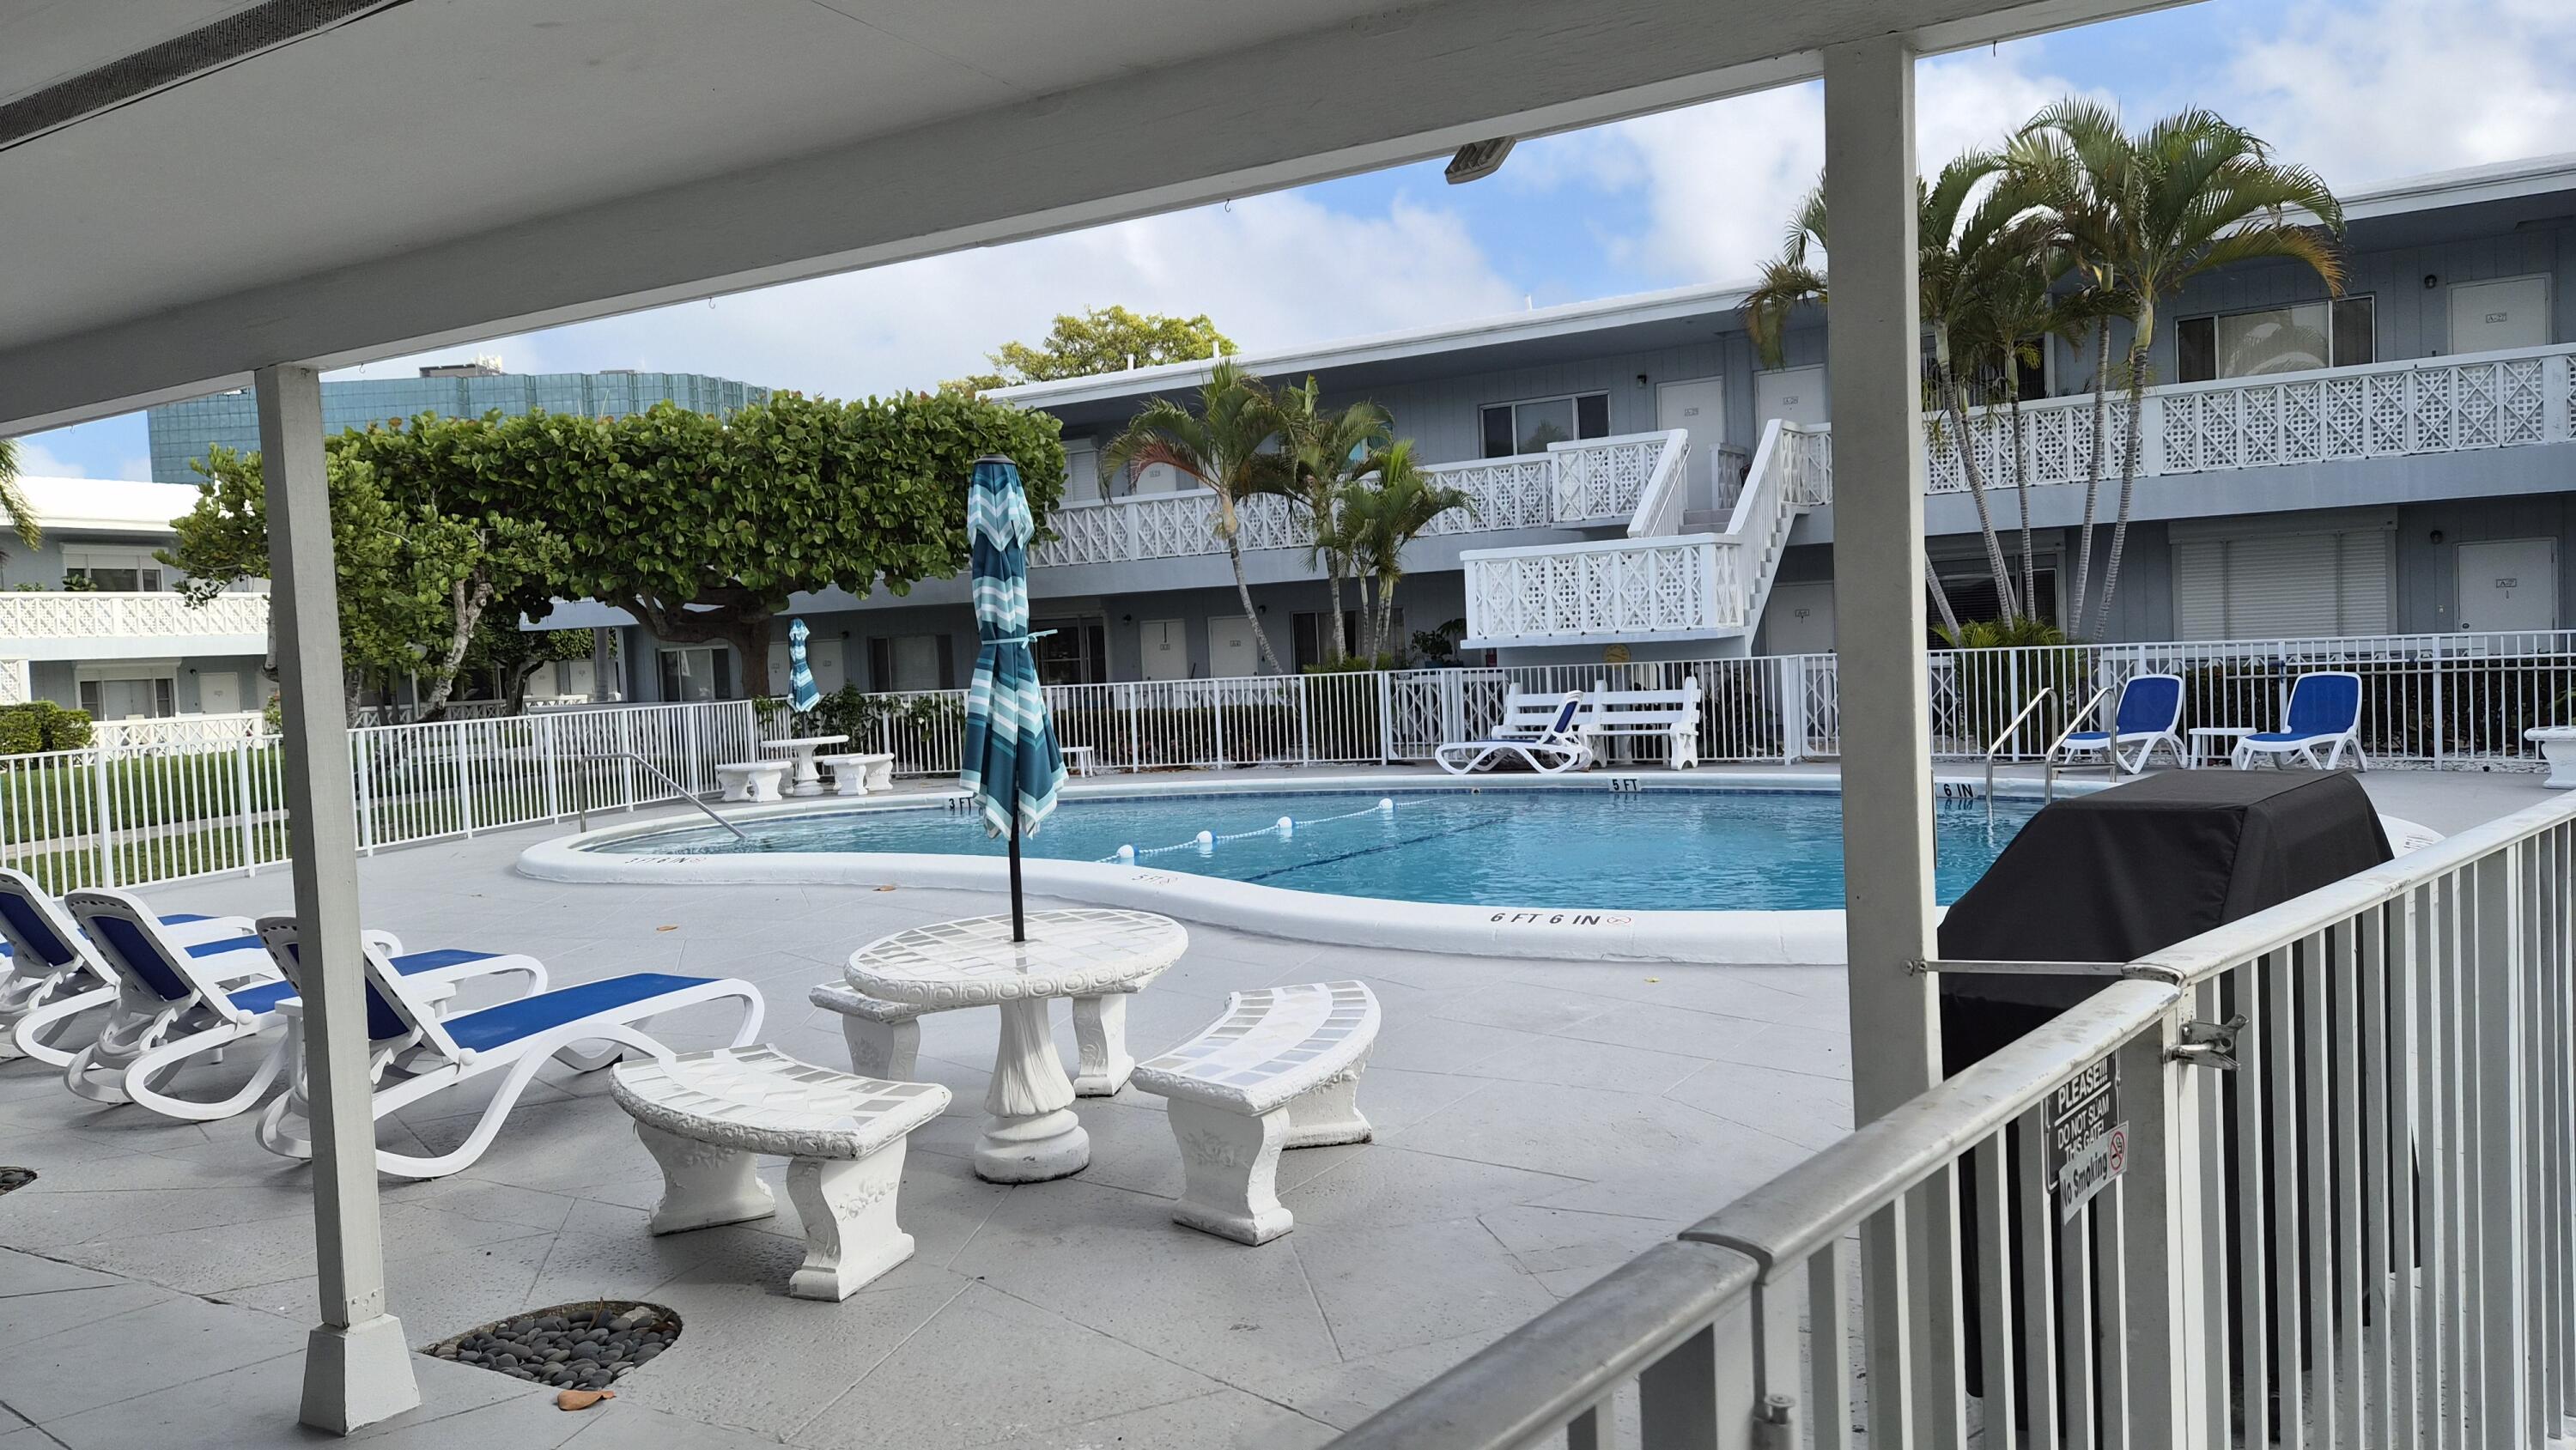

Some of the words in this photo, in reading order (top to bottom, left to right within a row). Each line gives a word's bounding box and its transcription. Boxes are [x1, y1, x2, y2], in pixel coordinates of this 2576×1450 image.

[1612, 778, 1620, 791] 5
[1623, 778, 1637, 791] FT
[1943, 783, 1953, 797] 6
[1956, 783, 1974, 798] IN
[949, 798, 956, 810] 3
[959, 797, 974, 810] FT
[1490, 913, 1506, 922] 6
[1510, 913, 1543, 924] FT
[1549, 914, 1564, 924] 6
[1572, 914, 1601, 925] IN
[2057, 1057, 2108, 1114] PLEASE!!!
[2057, 1127, 2070, 1150] DO
[2071, 1109, 2087, 1139] NOT
[2088, 1093, 2110, 1125] SLAM
[2064, 1135, 2083, 1162] THIS
[2061, 1179, 2073, 1208] No
[2073, 1151, 2108, 1198] Smoking
